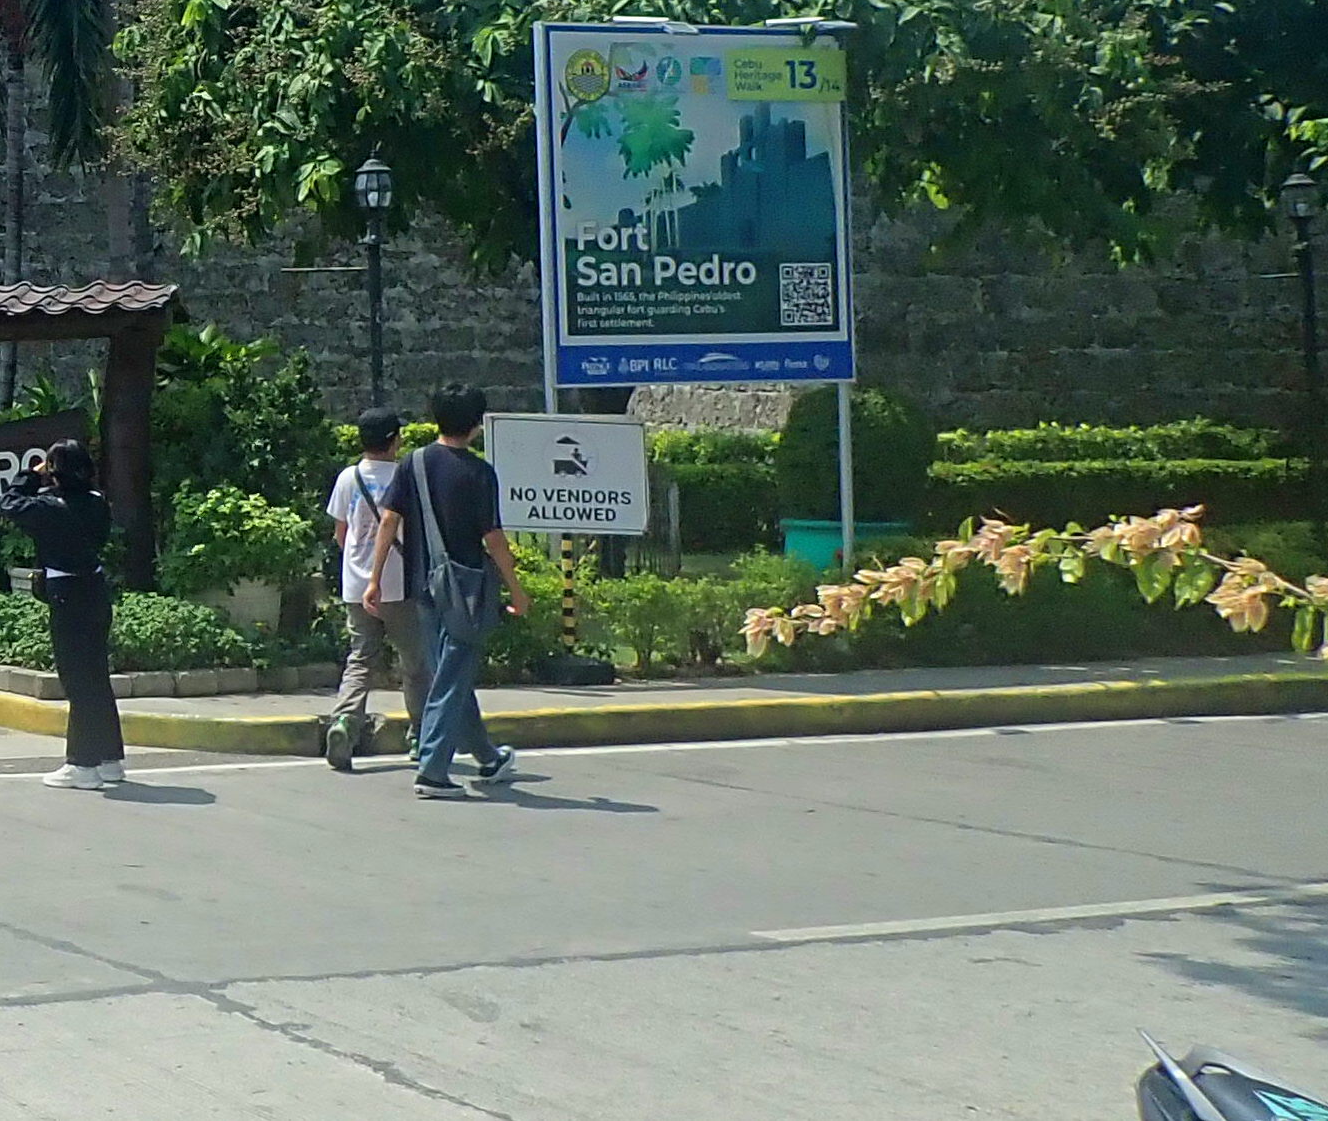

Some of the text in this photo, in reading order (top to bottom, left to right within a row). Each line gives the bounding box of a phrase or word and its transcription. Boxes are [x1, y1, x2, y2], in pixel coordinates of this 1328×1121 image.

[734, 60, 763, 69] Cebu
[734, 71, 782, 82] Heritage
[785, 60, 817, 89] 13
[734, 81, 762, 91] Walk
[577, 221, 650, 251] Fort
[576, 254, 757, 287] San Pedro
[577, 292, 600, 302] Built
[602, 292, 612, 301] in
[638, 292, 656, 301] the
[577, 304, 726, 317] triangular fort guarding Cebu's
[577, 318, 599, 328] first
[630, 359, 649, 372] BPI
[510, 487, 632, 505] NO VENDORS
[528, 506, 617, 521] ALLOWED
